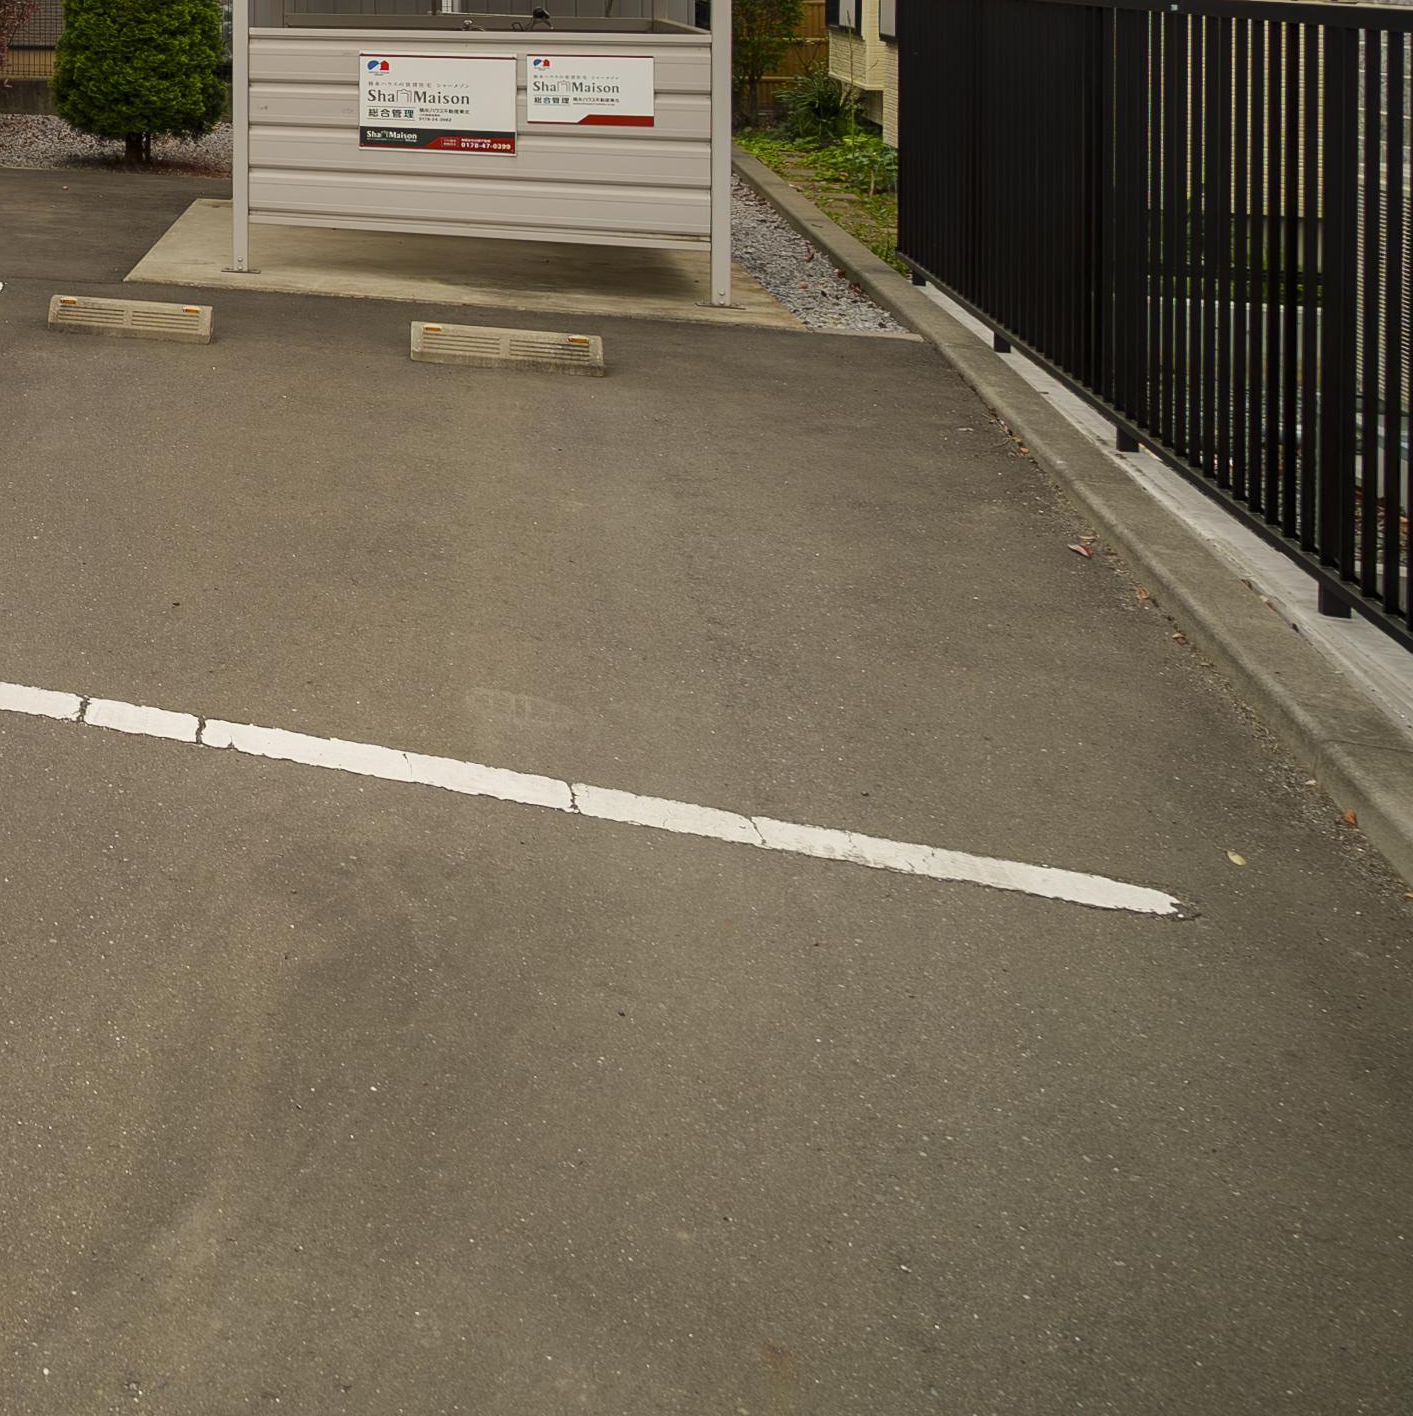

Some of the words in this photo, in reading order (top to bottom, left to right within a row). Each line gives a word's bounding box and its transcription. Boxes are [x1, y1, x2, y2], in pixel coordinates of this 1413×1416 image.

[533, 81, 557, 92] Sha
[572, 82, 620, 93] Maison
[367, 89, 395, 102] Sha
[413, 91, 470, 104] Maison
[368, 108, 414, 118] 総合管理
